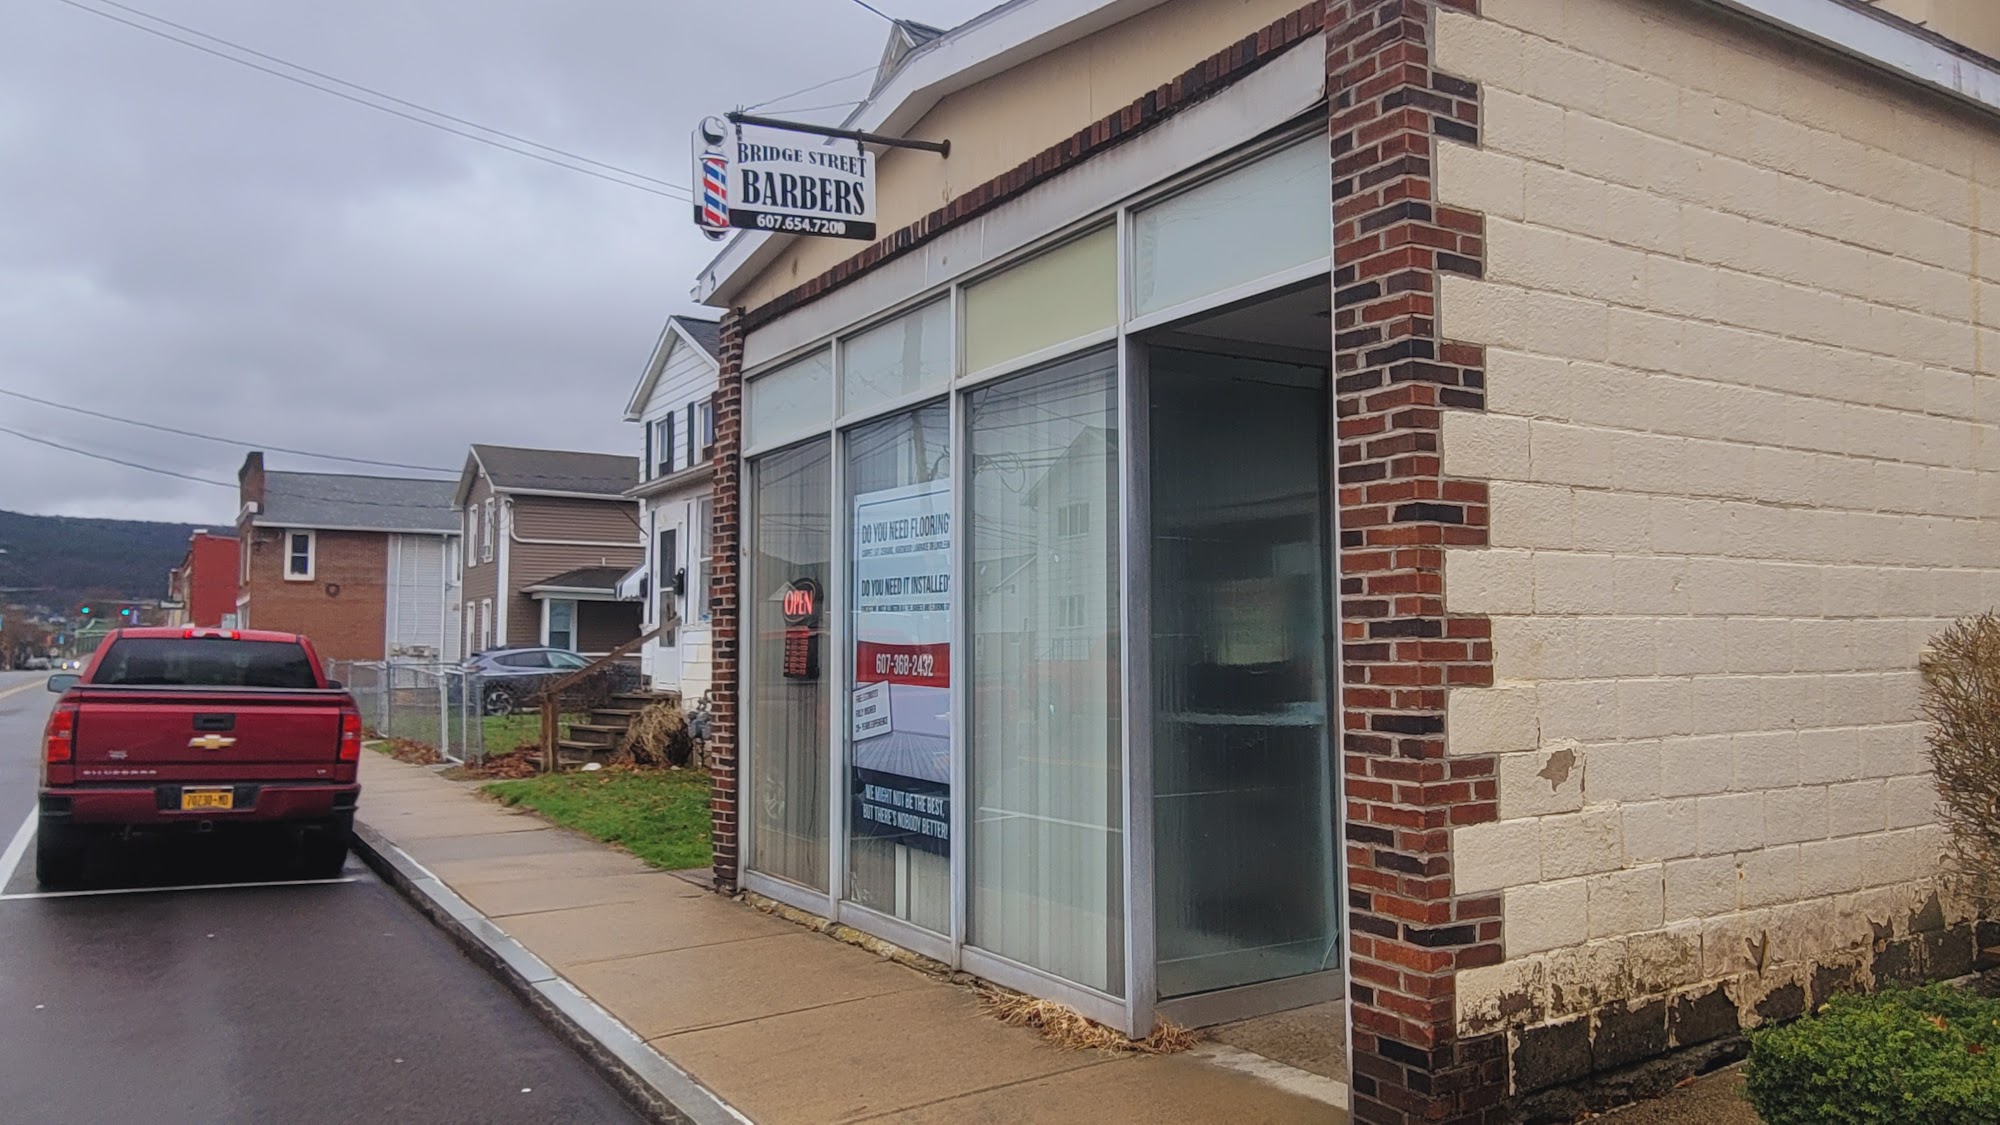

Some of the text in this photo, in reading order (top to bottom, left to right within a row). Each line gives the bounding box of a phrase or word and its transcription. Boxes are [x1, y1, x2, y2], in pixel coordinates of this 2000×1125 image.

[737, 142, 867, 178] BRIDGE STREET
[741, 169, 865, 216] BARBERS
[862, 524, 872, 544] DO
[873, 522, 888, 542] YOU
[889, 519, 909, 540] NEED
[861, 574, 950, 597] DO YOU NEED IT INSTALLED
[784, 590, 813, 615] OPEN
[876, 653, 934, 677] 607-368-2432
[865, 783, 945, 818] WE MIGHT NOT BE THE BEST,
[862, 803, 948, 840] BUT THERE'S NOBODY BETTER!
